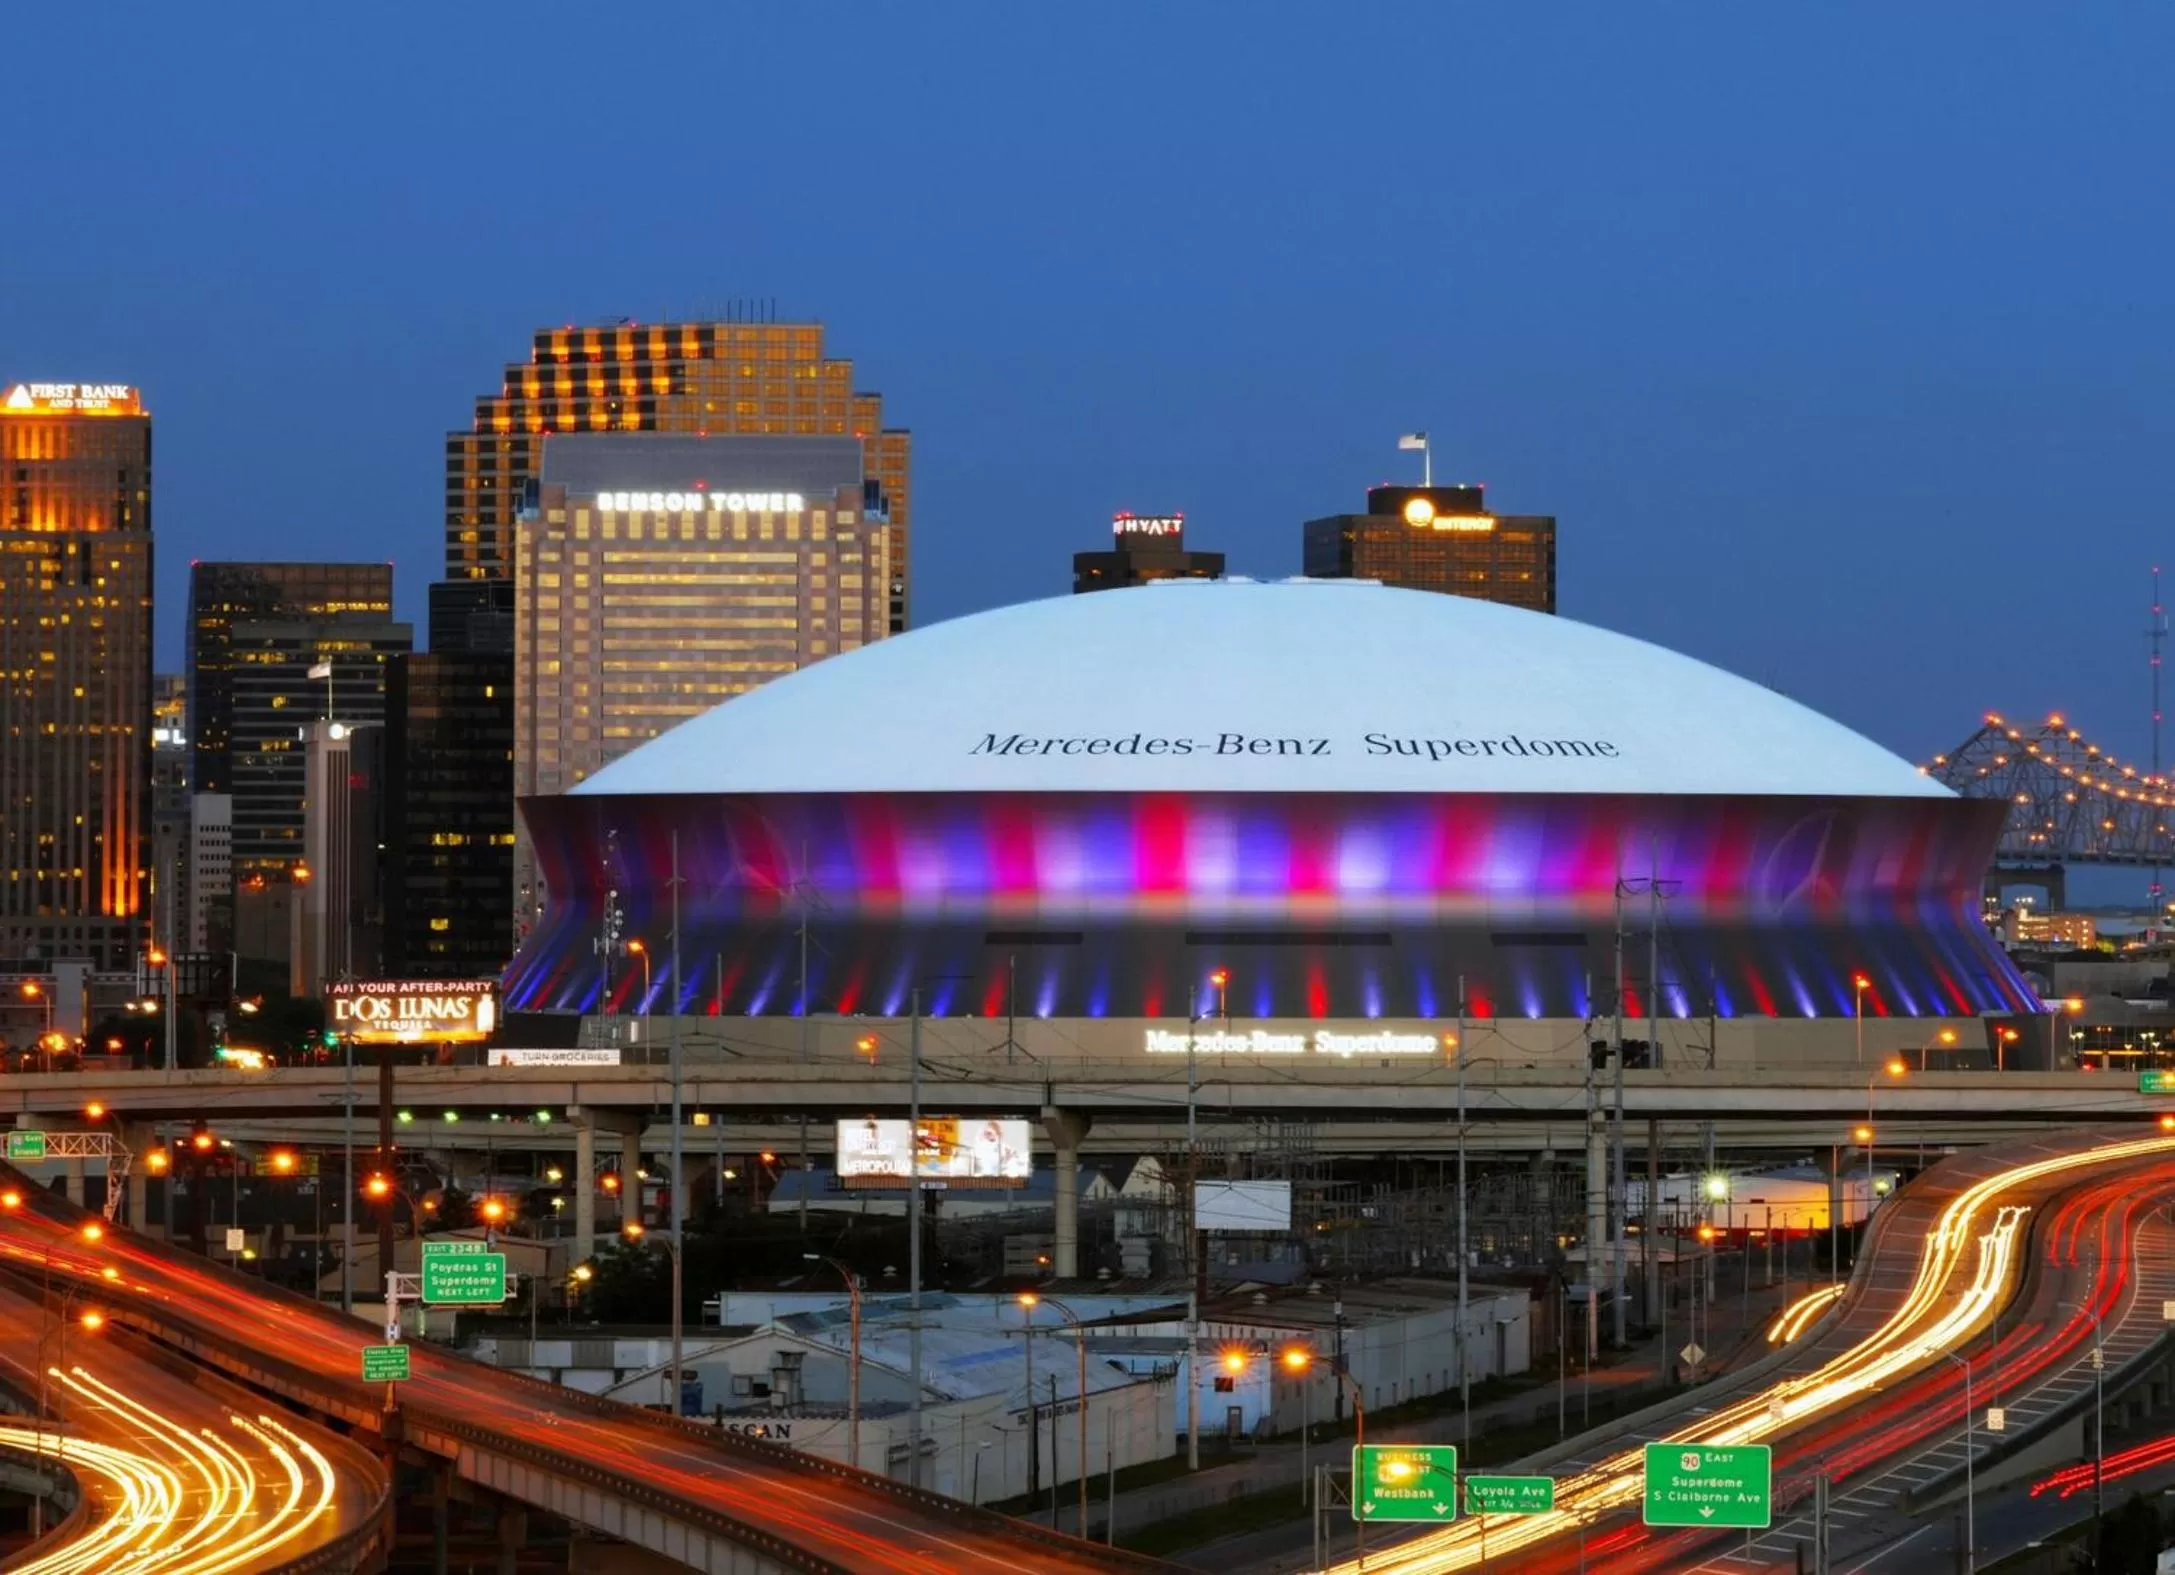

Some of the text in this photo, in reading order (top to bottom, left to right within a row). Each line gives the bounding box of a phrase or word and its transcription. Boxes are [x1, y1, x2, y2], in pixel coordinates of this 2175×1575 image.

[30, 384, 128, 399] FIRST BANK
[49, 400, 110, 408] AND TRUST
[597, 492, 803, 511] BENSON TOWER
[1125, 520, 1182, 535] HYATT
[968, 733, 1620, 761] Mercedes-Benz Superdome
[359, 983, 396, 992] YOUR
[400, 982, 491, 992] AFTER-PARTY
[399, 997, 472, 1019] LUNAS
[1146, 1030, 1438, 1058] Mercedes-Benz Superdome
[430, 1262, 478, 1273] Poydras
[431, 1276, 497, 1286] Superdome
[1683, 1453, 1734, 1468] 90 EAST
[1671, 1476, 1743, 1488] Superdome
[1374, 1488, 1434, 1499] Westbank
[1473, 1486, 1546, 1497] Loyola Ave
[1654, 1490, 1761, 1503] S Claiborne Ave
